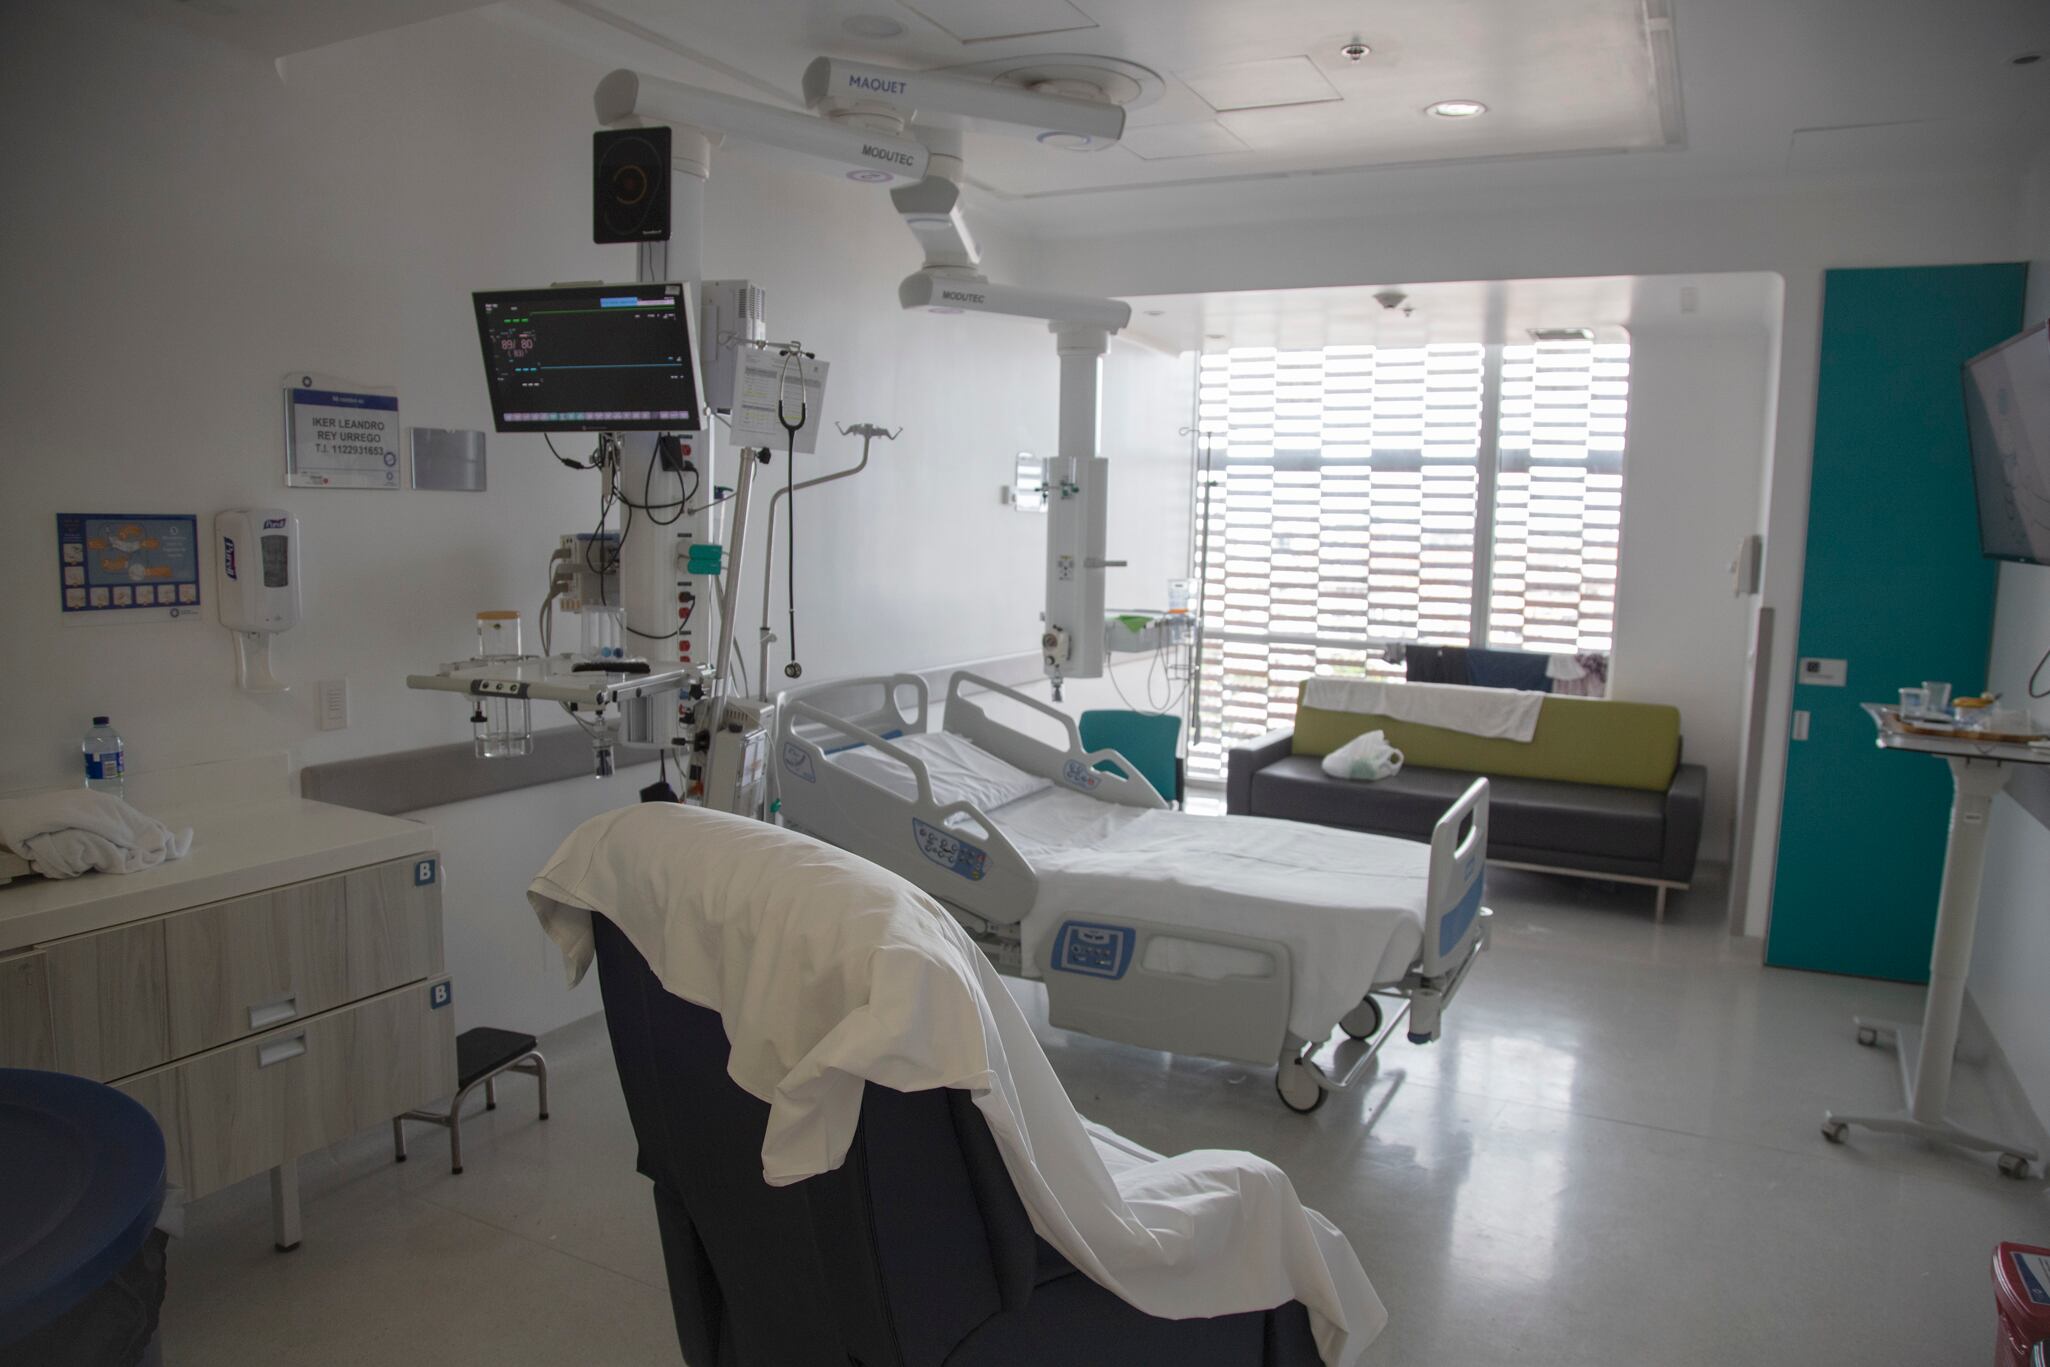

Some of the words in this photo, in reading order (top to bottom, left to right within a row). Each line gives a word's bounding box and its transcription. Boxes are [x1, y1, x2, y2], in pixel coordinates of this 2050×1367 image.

[849, 75, 906, 94] MAQUET
[862, 144, 914, 167] MODUTEC
[942, 289, 985, 305] MODUTEC
[312, 417, 336, 428] IKER
[338, 419, 385, 431] LEANDRO
[317, 430, 337, 441] REY
[340, 432, 381, 444] URREGO
[419, 862, 431, 881] B
[435, 984, 447, 1003] B
